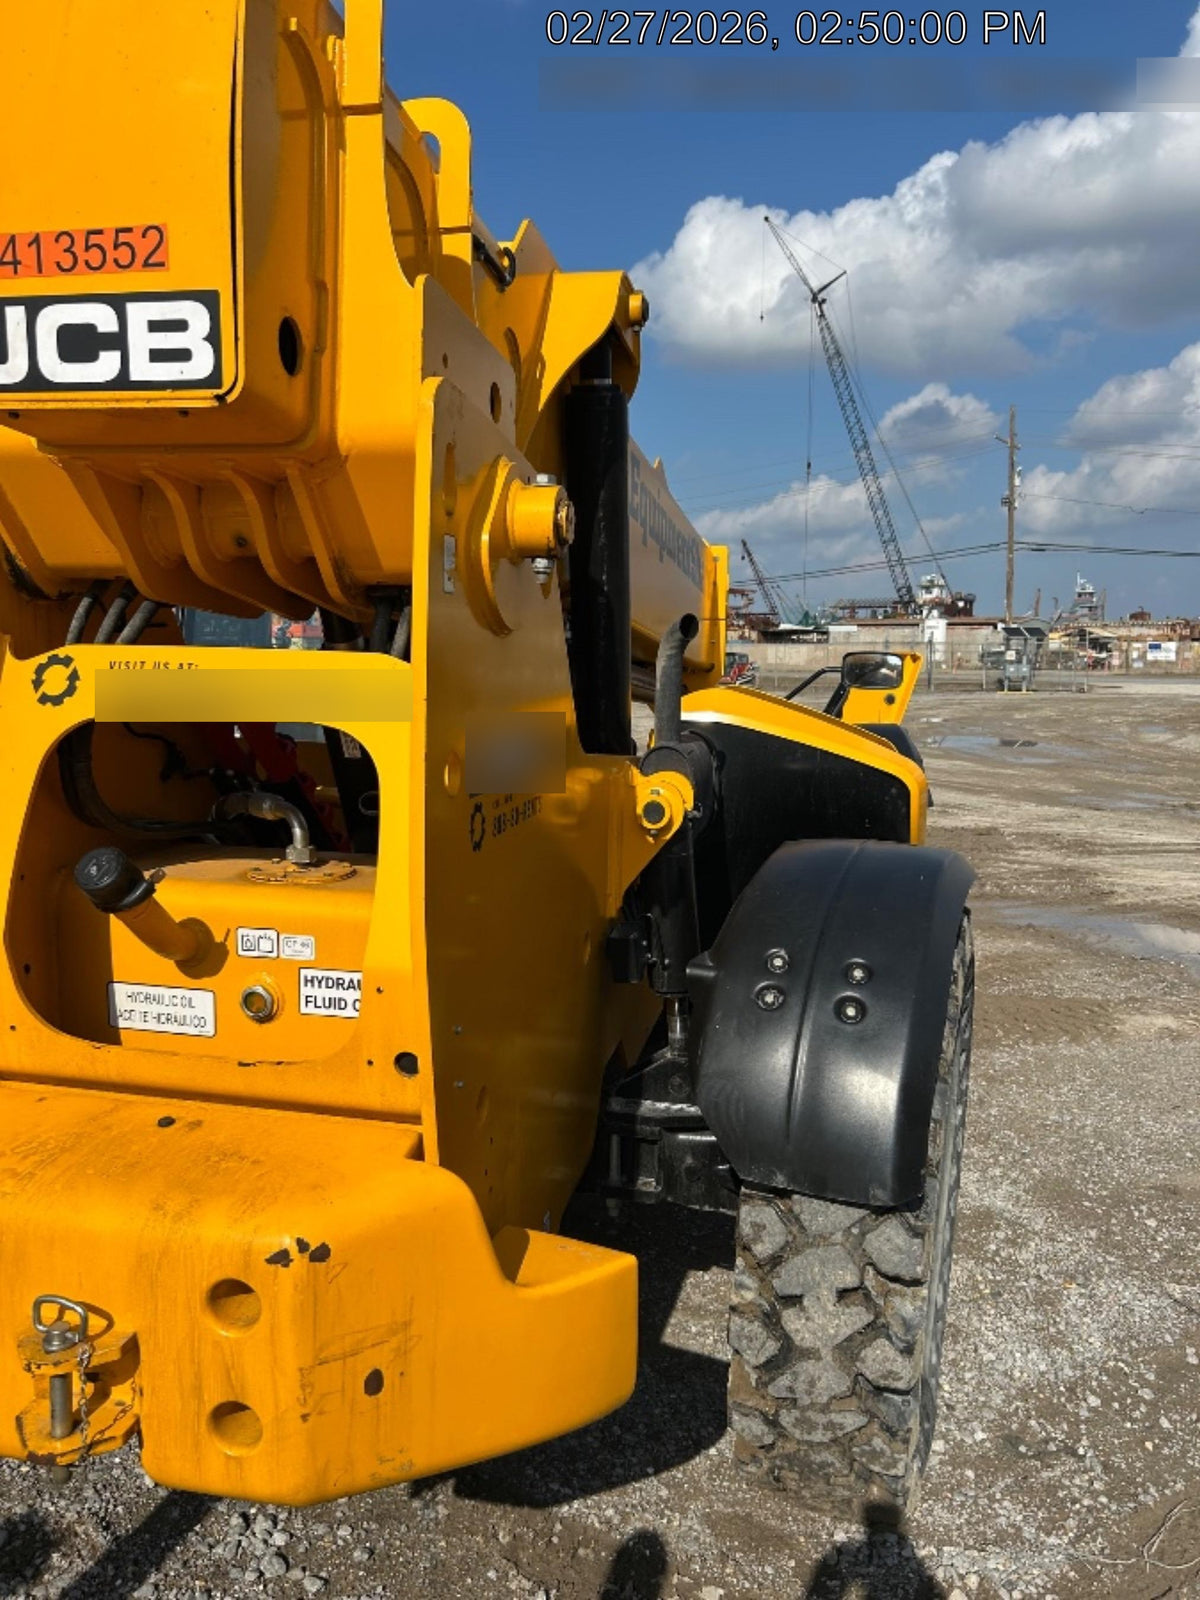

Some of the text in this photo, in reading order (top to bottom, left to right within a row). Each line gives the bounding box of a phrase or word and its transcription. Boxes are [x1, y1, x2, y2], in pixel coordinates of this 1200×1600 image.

[0, 225, 166, 275] 413552
[0, 300, 215, 385] JCB
[109, 660, 147, 670] VISIT
[305, 995, 348, 1011] FLUID
